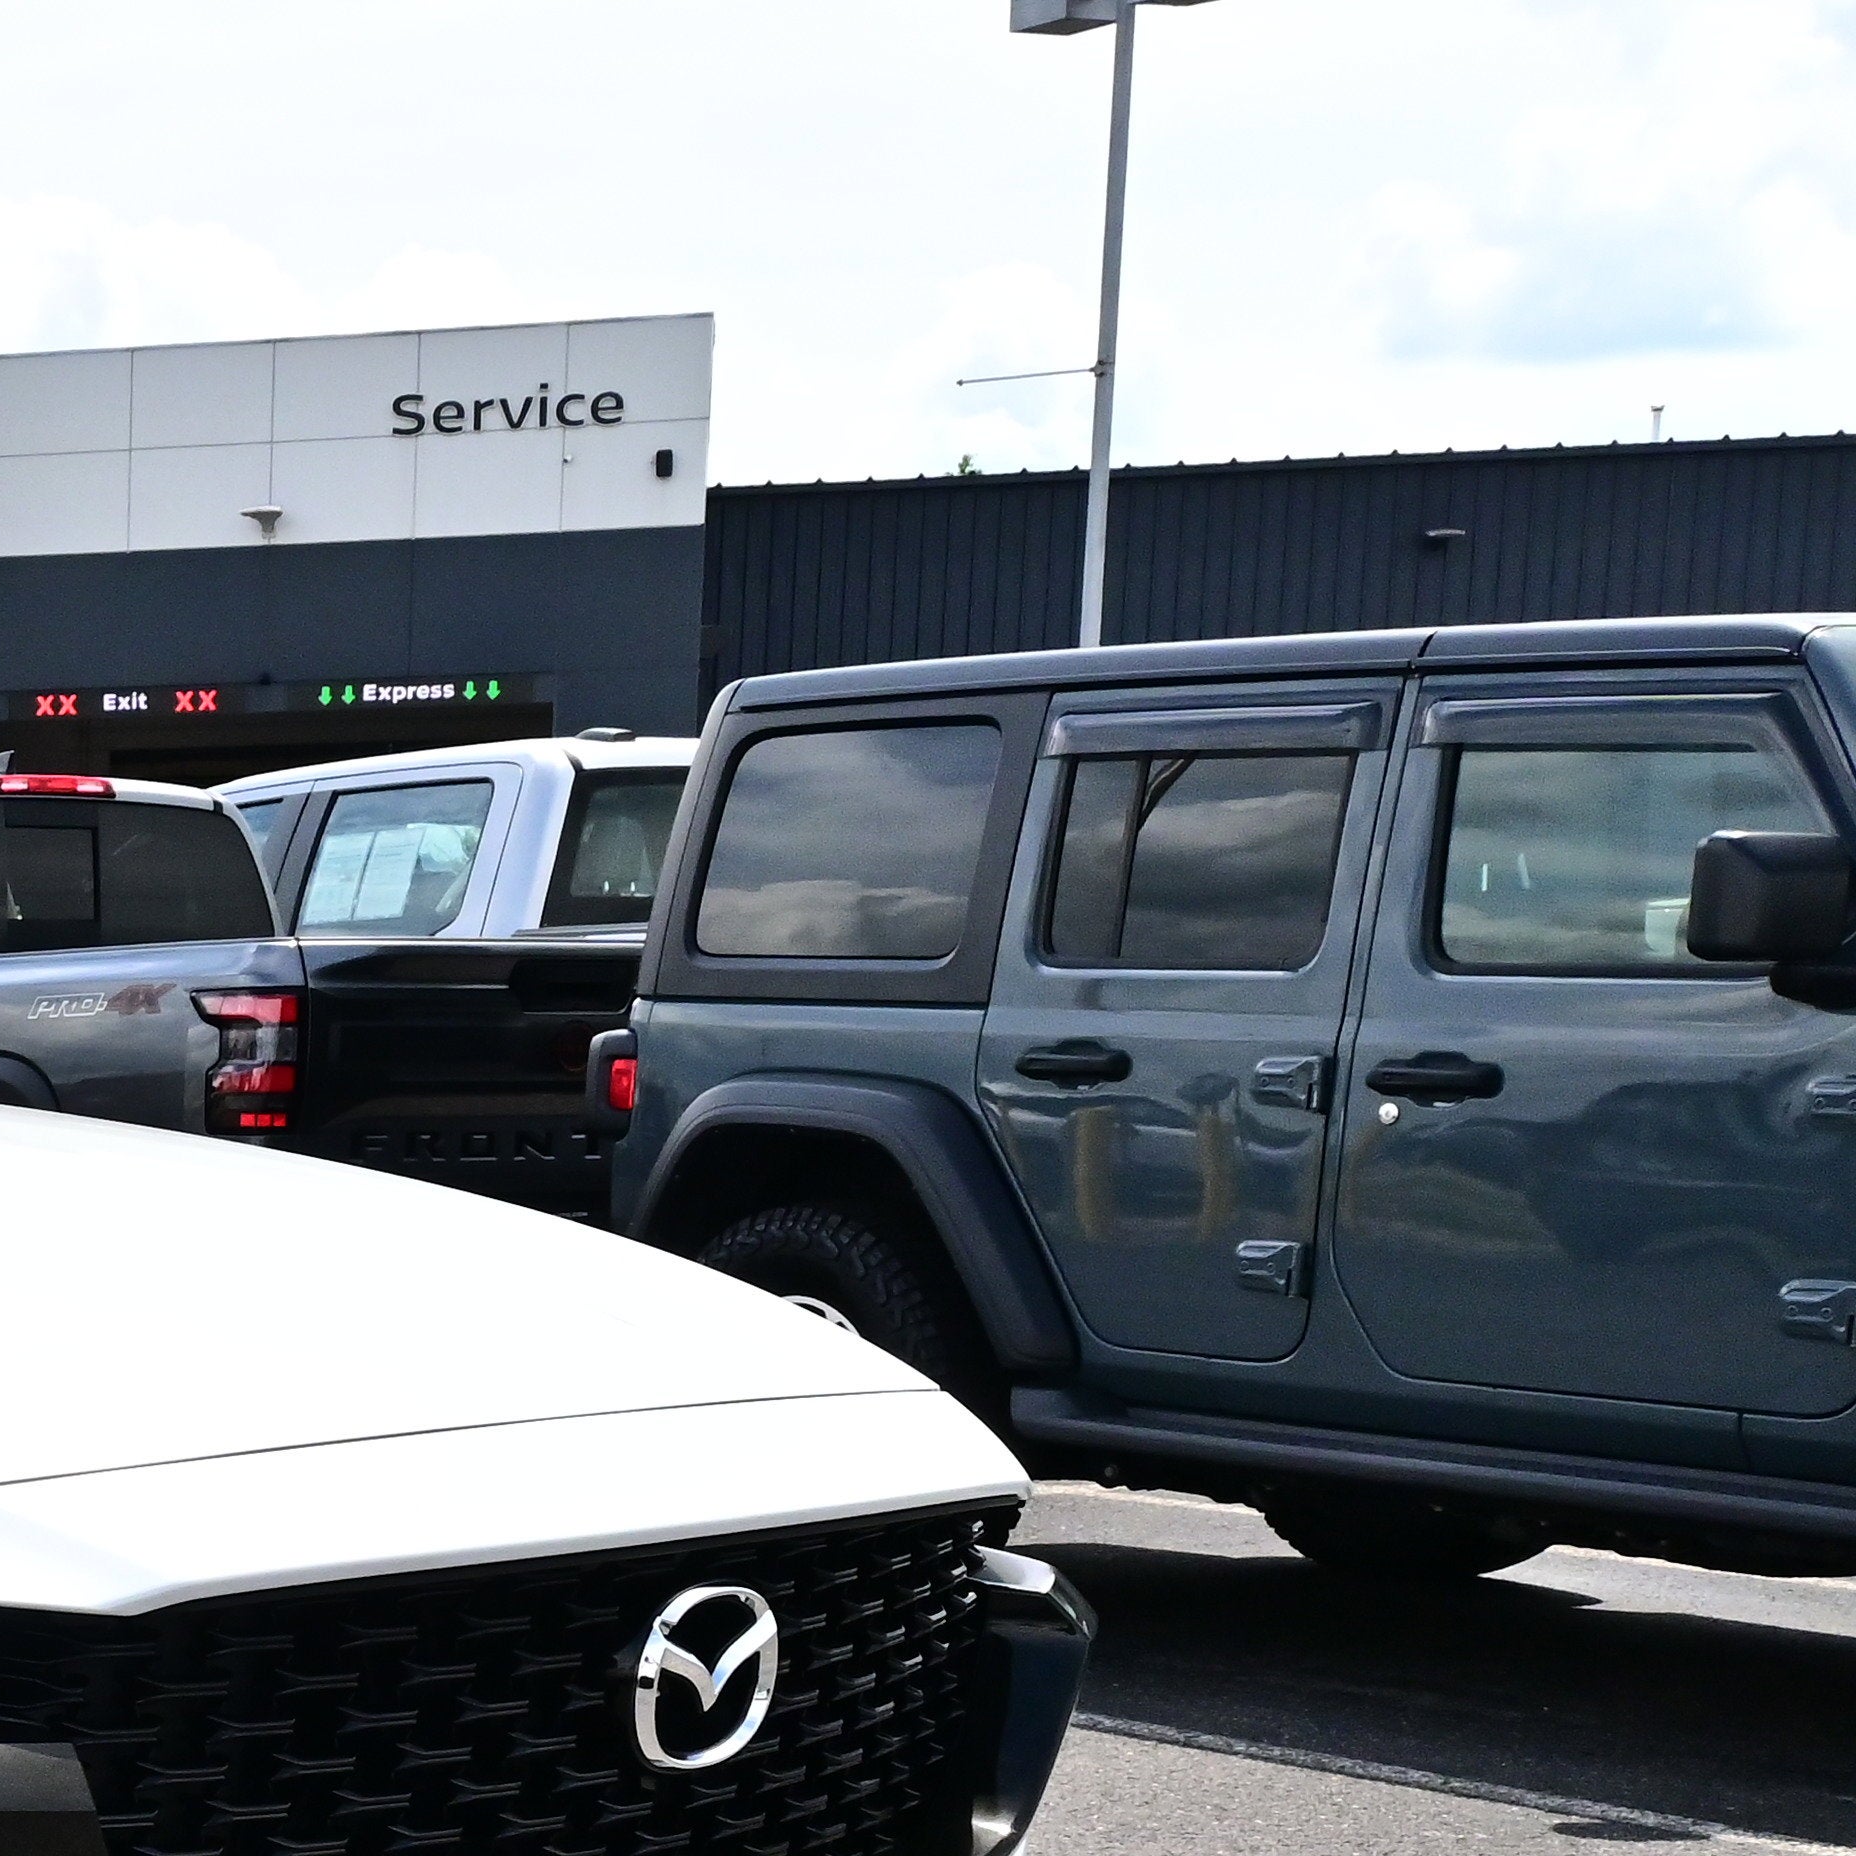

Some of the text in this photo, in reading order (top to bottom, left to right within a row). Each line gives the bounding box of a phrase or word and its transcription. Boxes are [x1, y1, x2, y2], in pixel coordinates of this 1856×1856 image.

[392, 383, 625, 436] Service
[103, 692, 148, 712] Exit
[362, 682, 456, 703] Express
